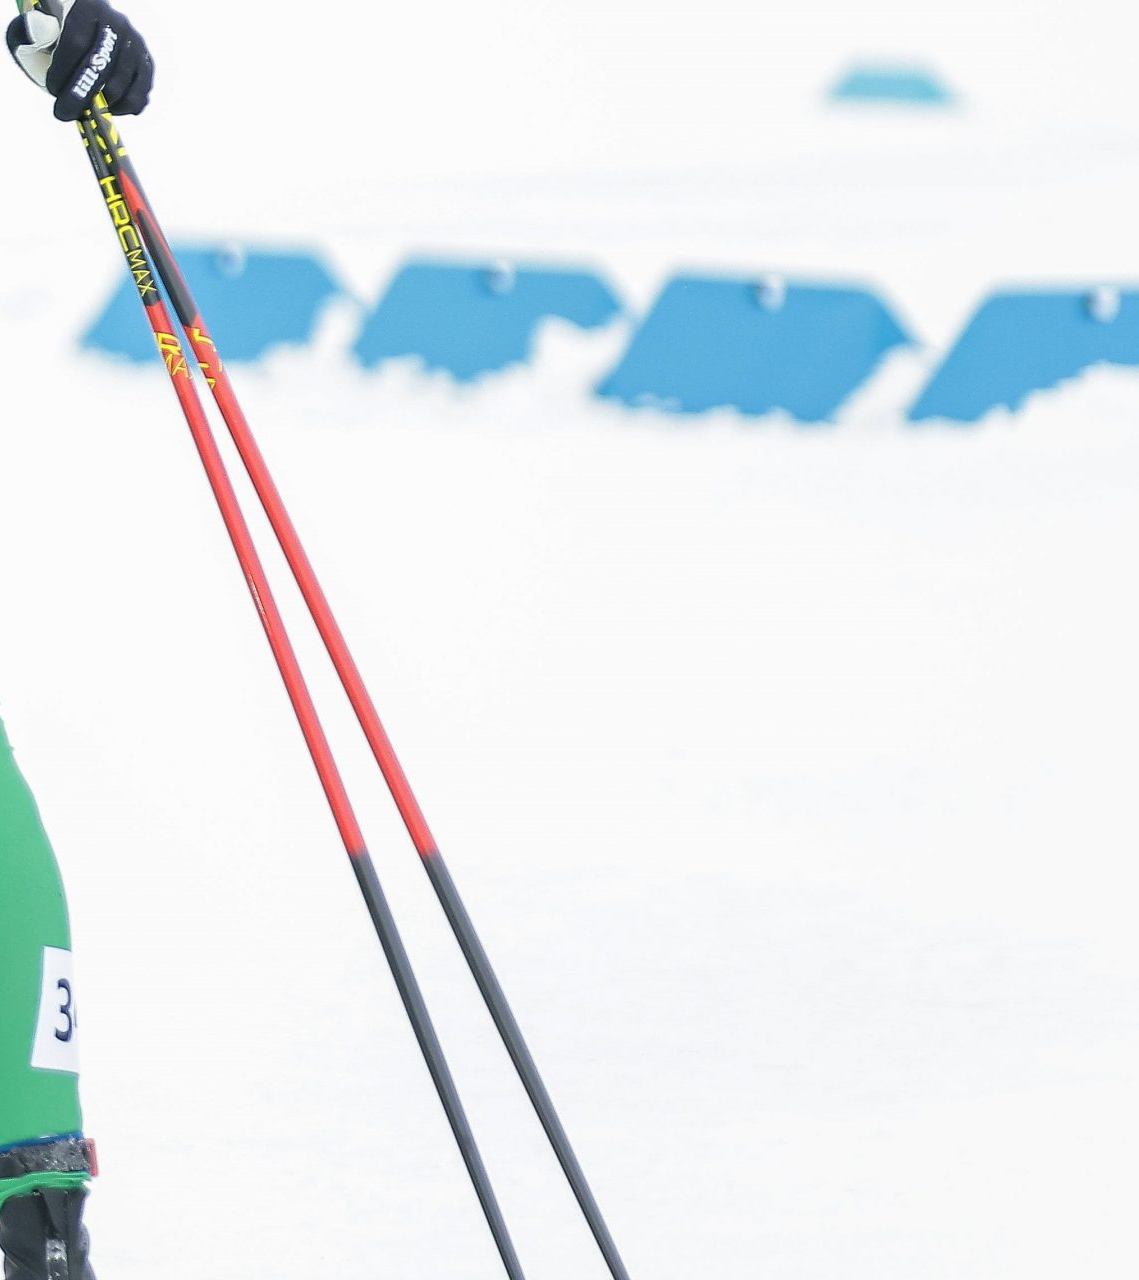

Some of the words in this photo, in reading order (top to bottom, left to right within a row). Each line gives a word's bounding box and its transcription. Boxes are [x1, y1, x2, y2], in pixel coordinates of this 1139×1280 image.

[100, 176, 142, 251] HRC
[127, 249, 158, 298] MAX
[55, 978, 78, 1043] 3
